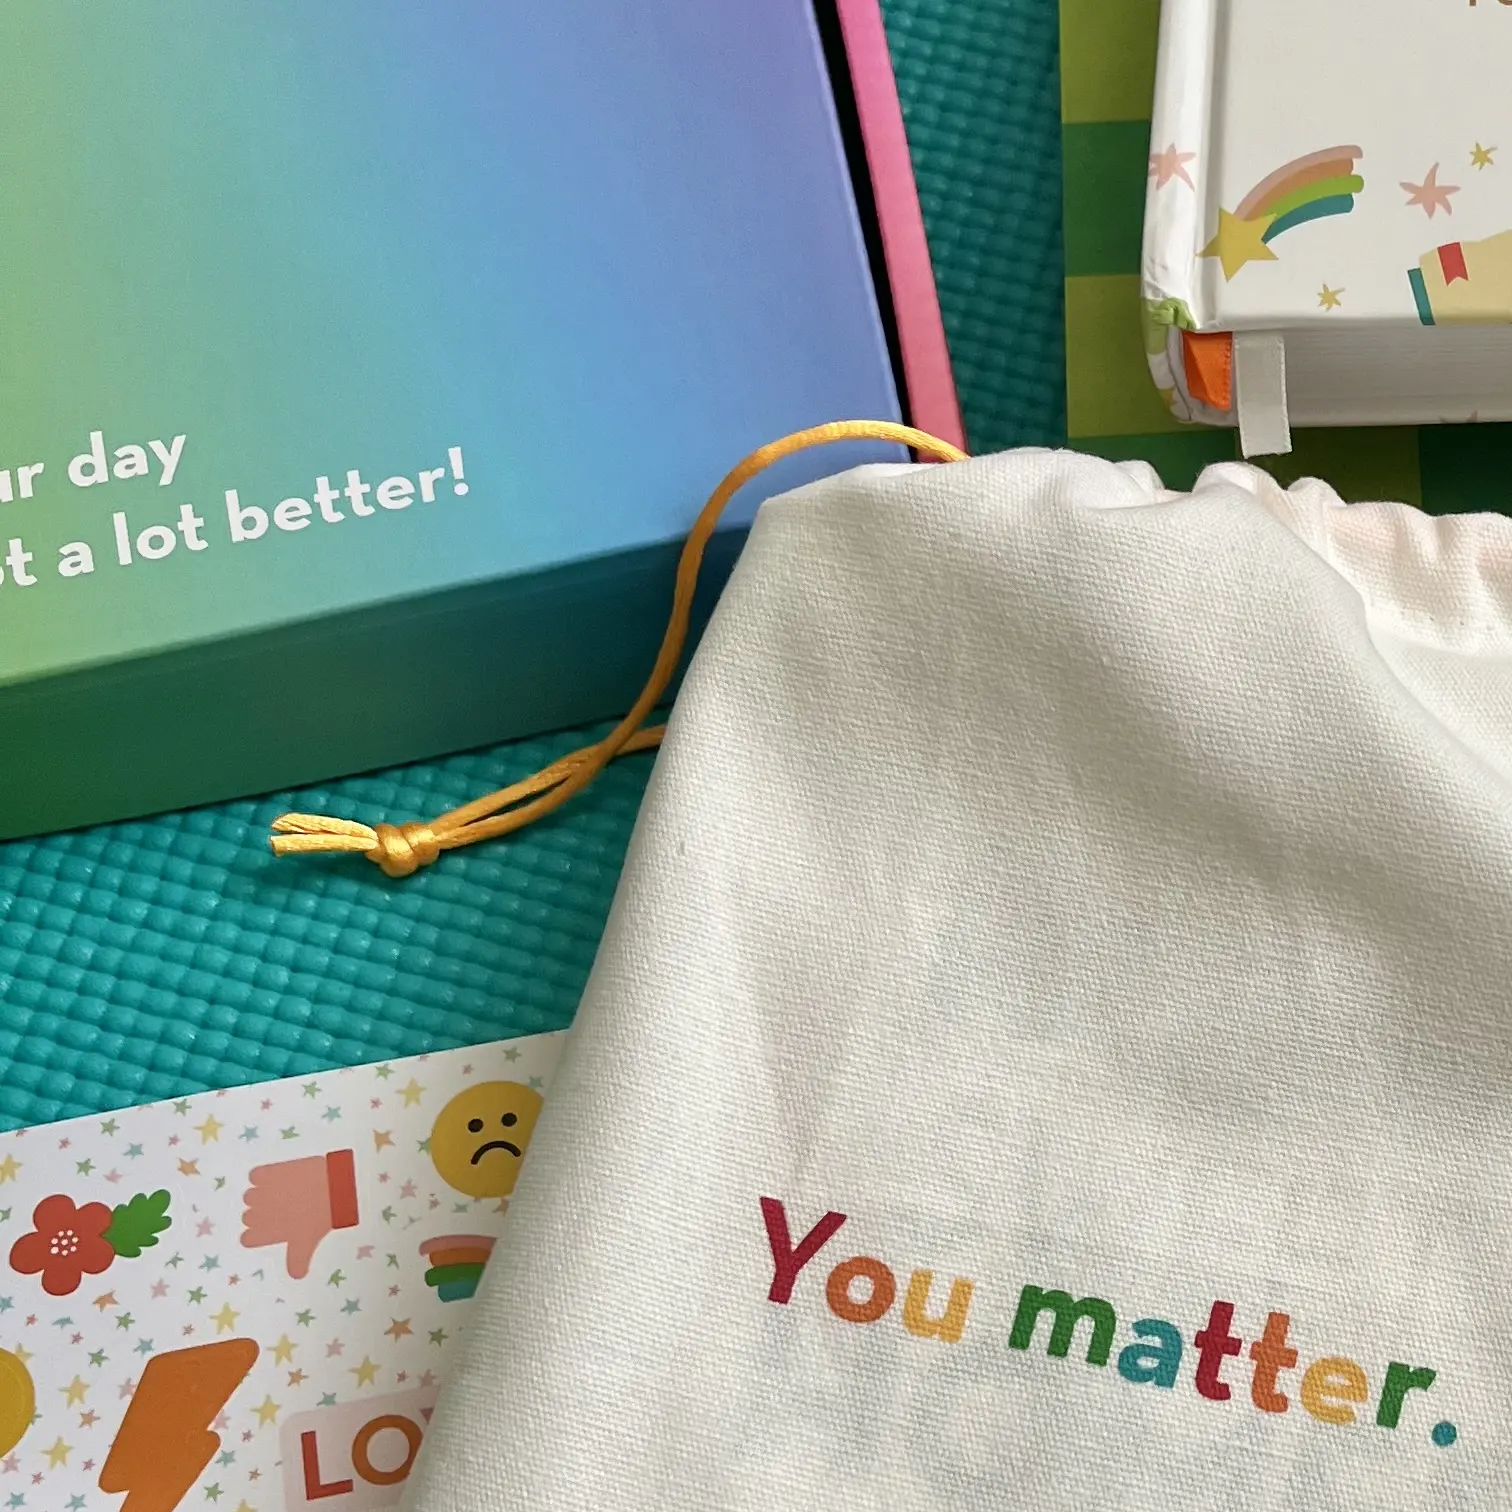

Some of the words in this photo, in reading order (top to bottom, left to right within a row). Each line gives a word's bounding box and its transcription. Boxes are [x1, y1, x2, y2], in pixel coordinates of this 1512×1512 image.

[0, 537, 38, 587] t
[58, 541, 95, 577] a
[112, 503, 209, 566] lot
[225, 446, 470, 543] better!
[67, 430, 187, 487] day
[760, 1196, 975, 1344] You
[1008, 1283, 1458, 1448] matter.
[300, 1406, 436, 1502] LO
